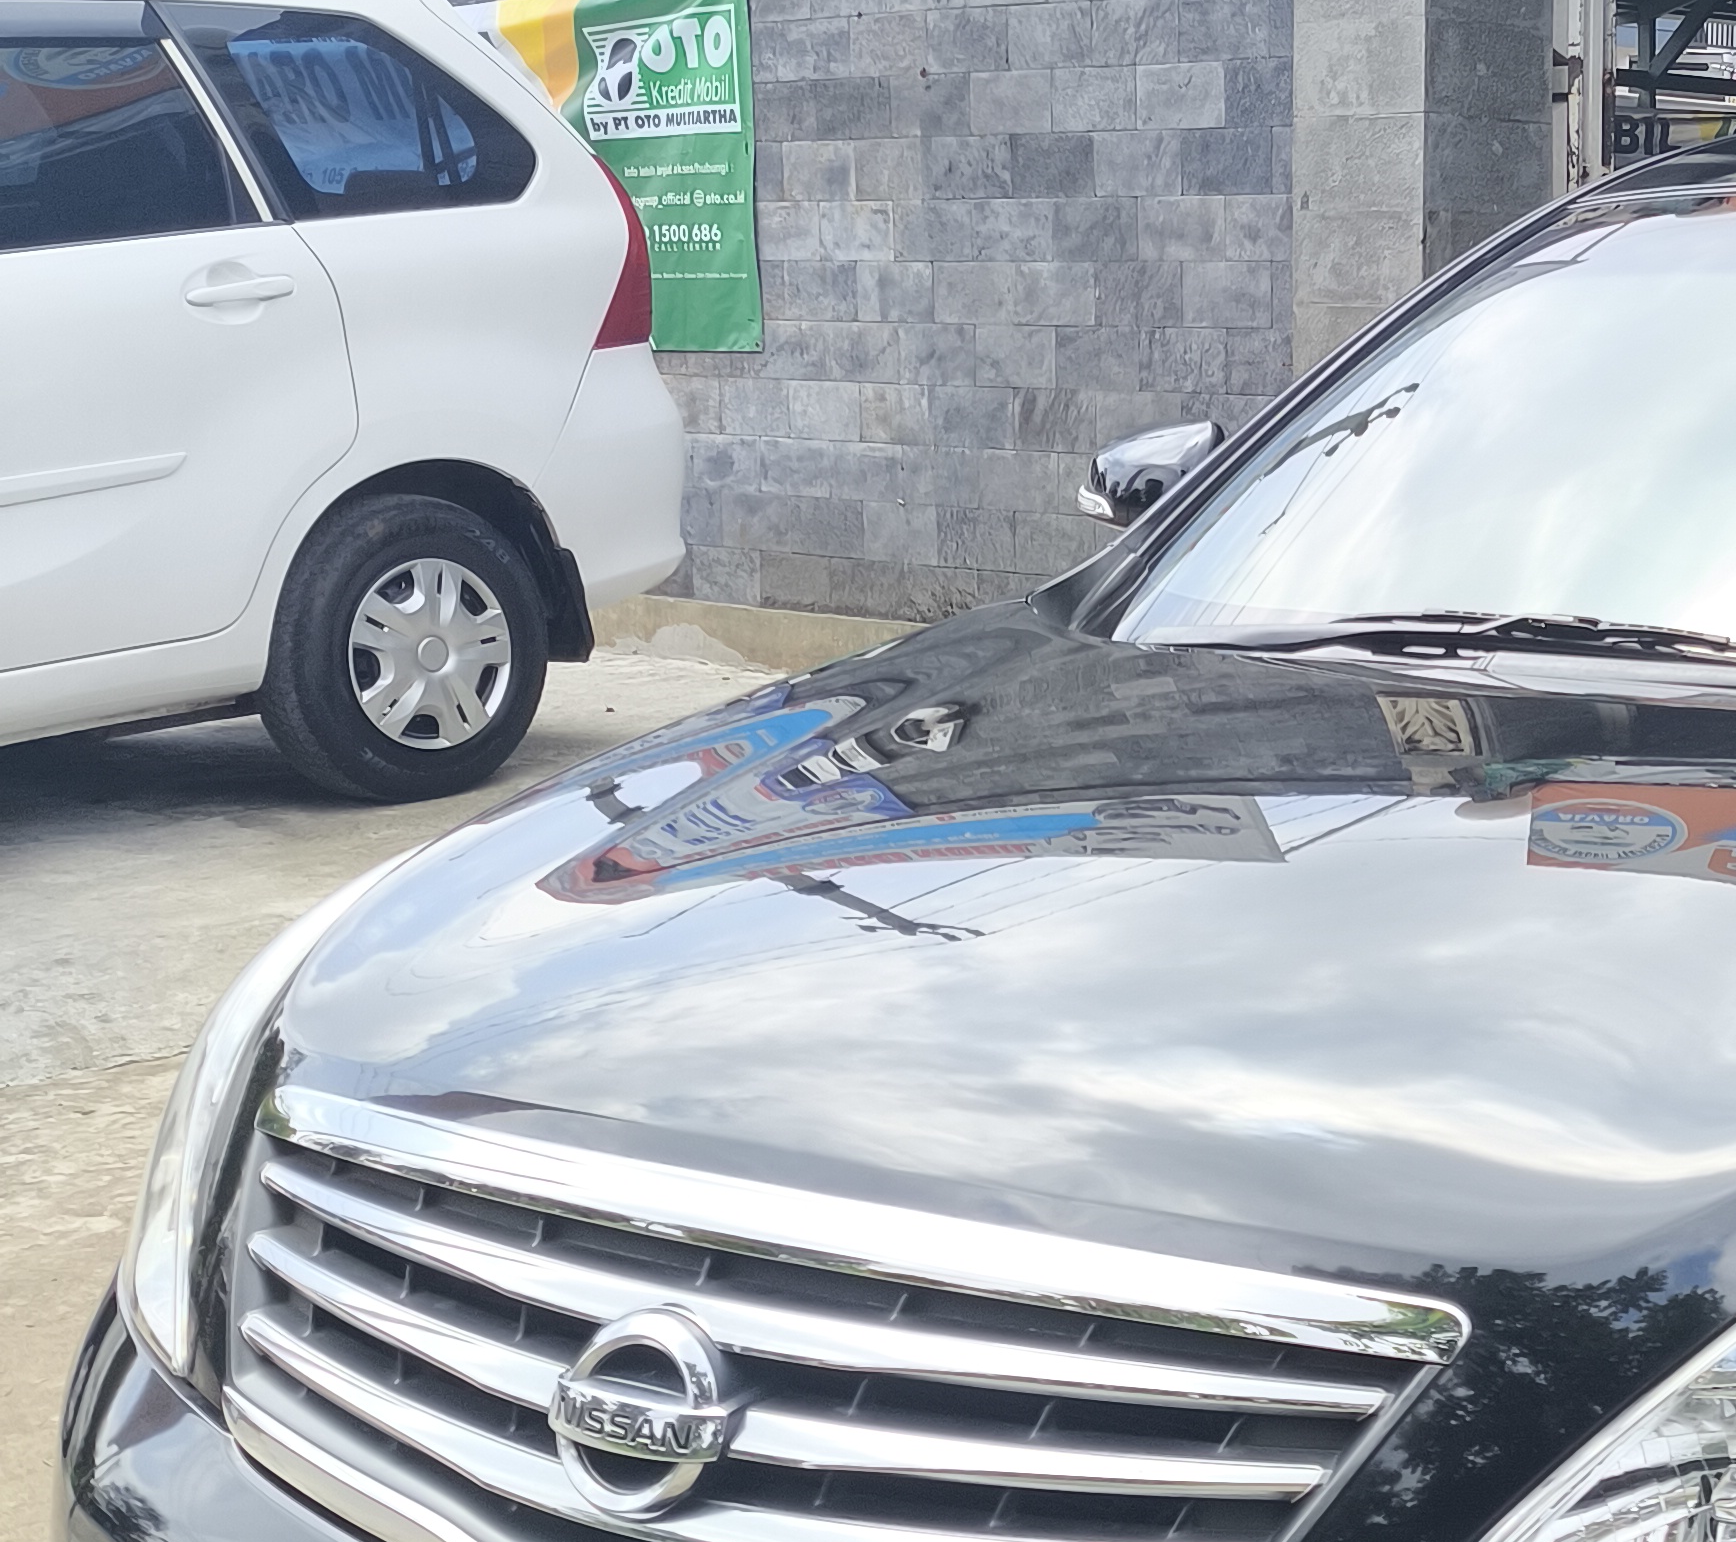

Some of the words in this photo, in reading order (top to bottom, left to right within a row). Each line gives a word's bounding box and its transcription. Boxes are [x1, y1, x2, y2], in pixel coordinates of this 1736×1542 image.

[640, 14, 732, 73] OTO
[649, 76, 693, 107] Kredit
[694, 73, 730, 103] Mobil
[590, 117, 608, 135] by
[612, 115, 630, 131] PT
[634, 113, 661, 129] OTO
[652, 224, 689, 242] 1500
[691, 223, 722, 242] 686
[654, 242, 678, 252] CALL
[554, 1388, 694, 1454] NISSAN
